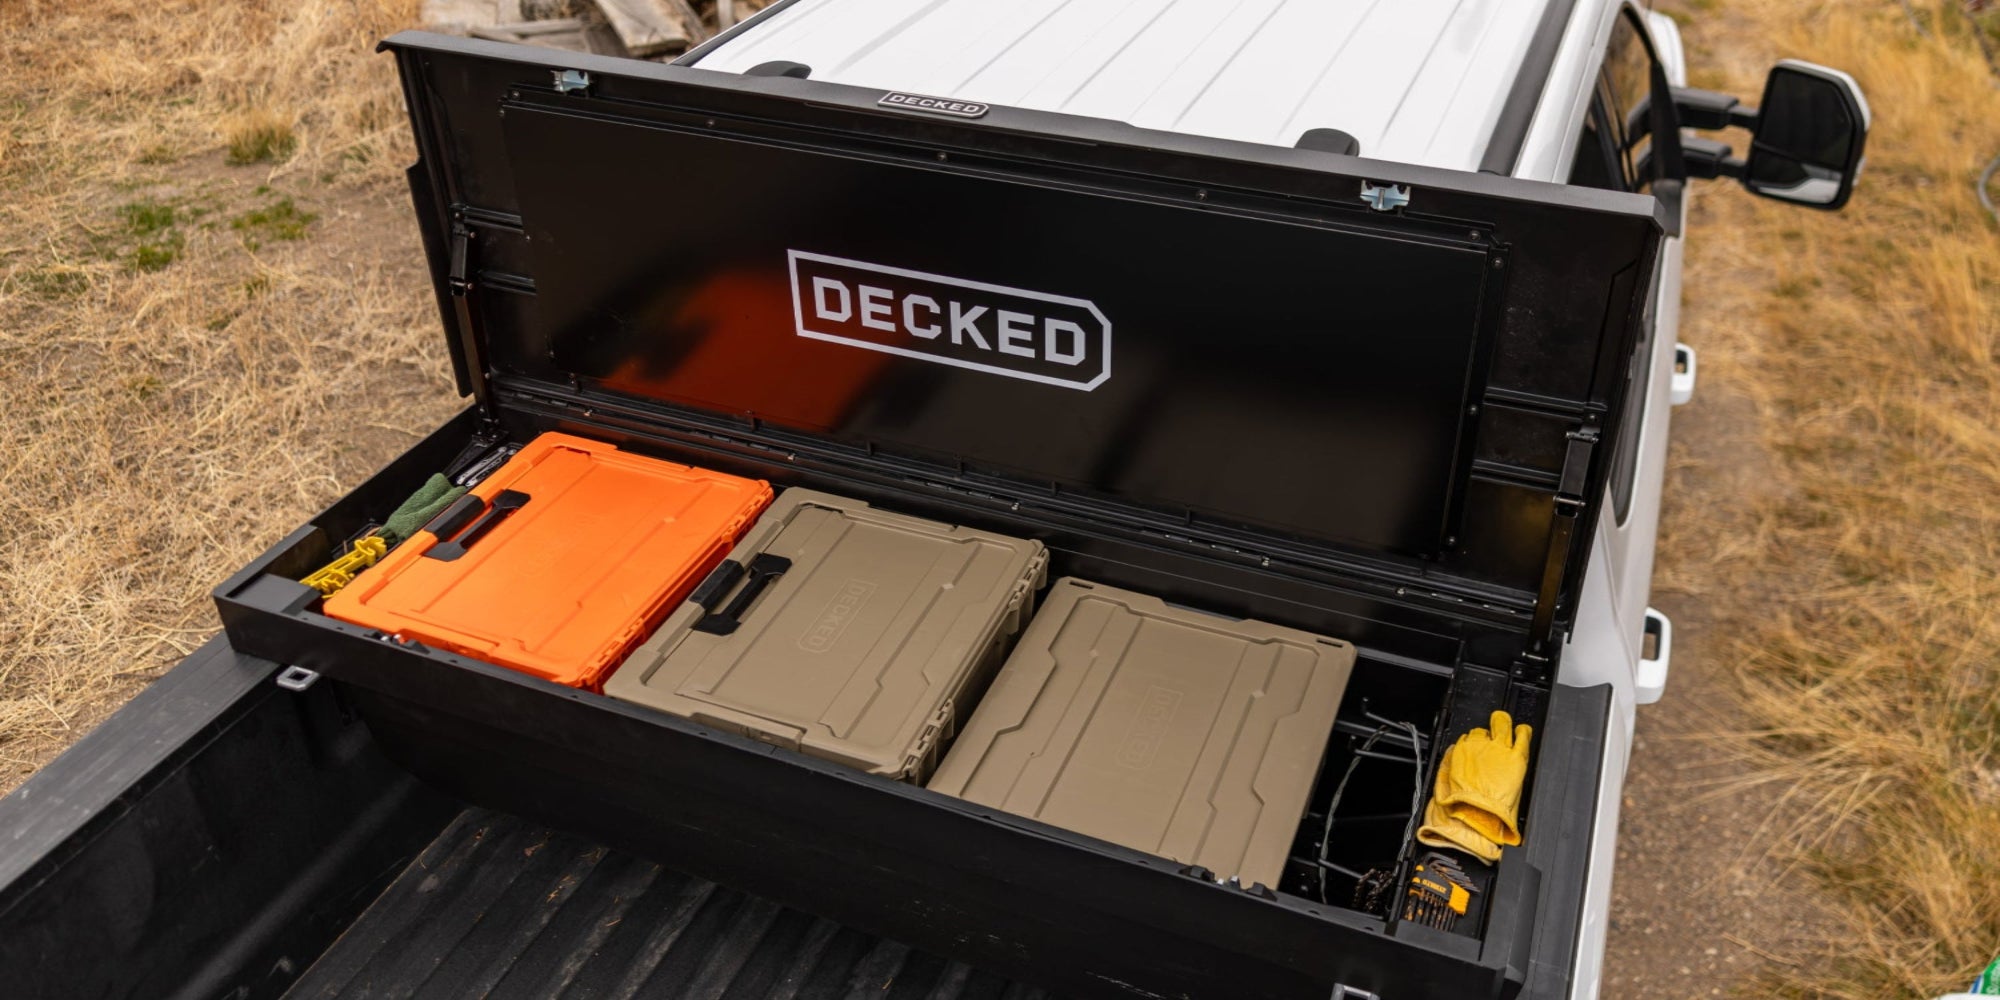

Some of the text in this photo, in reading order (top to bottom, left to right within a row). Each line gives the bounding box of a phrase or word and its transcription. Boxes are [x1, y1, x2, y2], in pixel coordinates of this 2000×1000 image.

[888, 94, 980, 113] DECKED
[812, 275, 1086, 366] DECKED
[808, 584, 867, 647] DECKED
